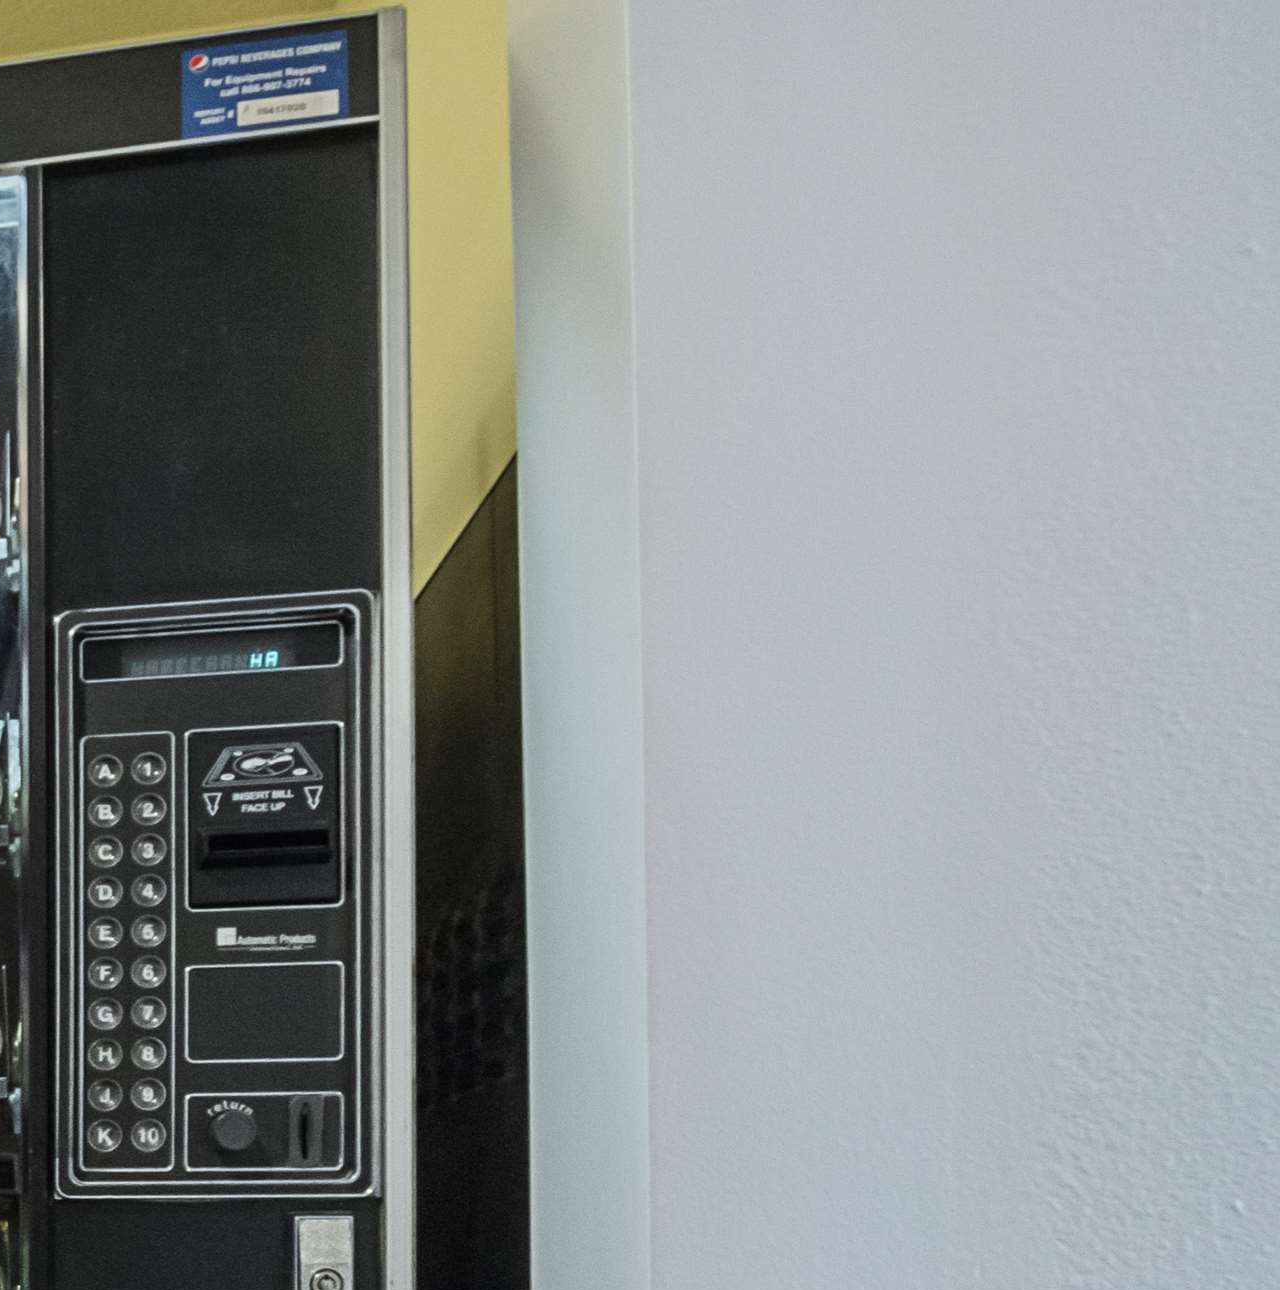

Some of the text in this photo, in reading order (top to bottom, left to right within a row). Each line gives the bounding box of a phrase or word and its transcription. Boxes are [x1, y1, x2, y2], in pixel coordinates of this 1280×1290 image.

[250, 651, 278, 668] HA
[231, 789, 295, 801] INSERT BILL
[241, 801, 286, 813] FACE UP
[207, 1100, 254, 1116] return
